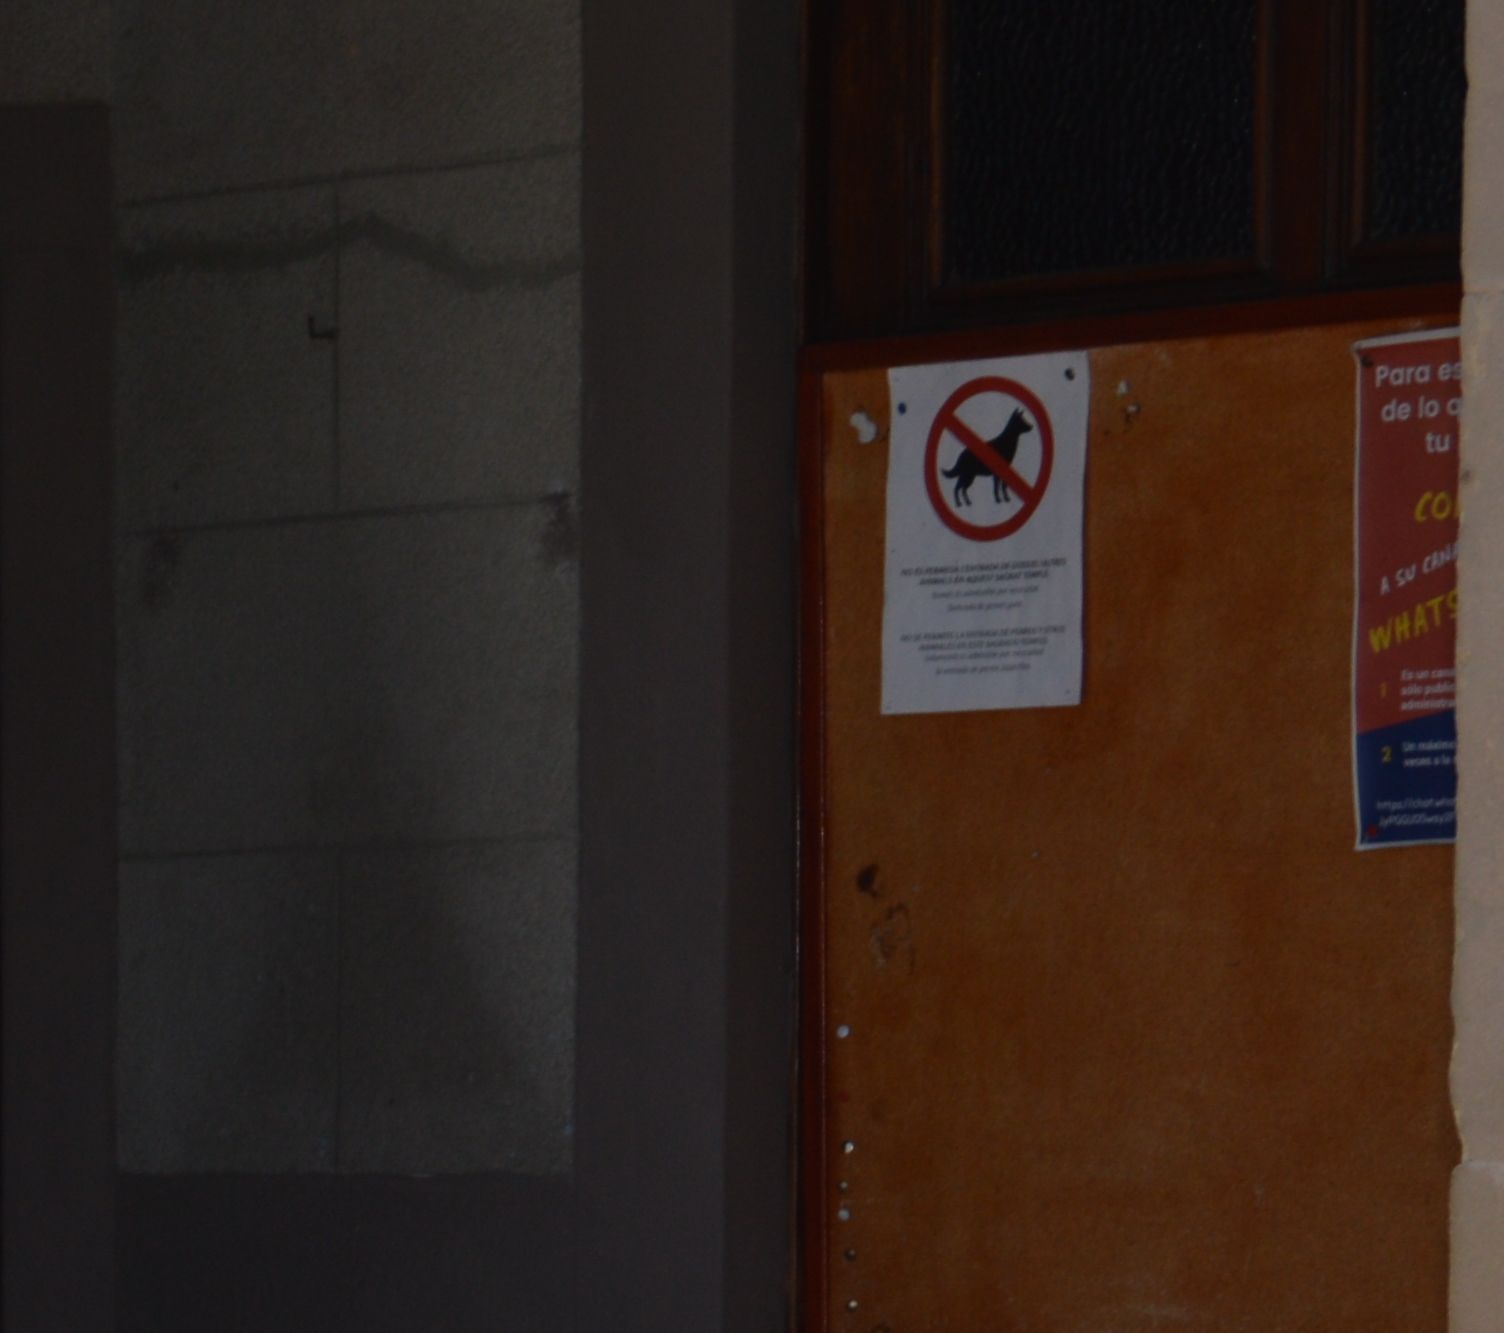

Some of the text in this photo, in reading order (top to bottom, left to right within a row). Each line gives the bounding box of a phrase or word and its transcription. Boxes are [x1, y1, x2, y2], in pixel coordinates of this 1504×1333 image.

[1374, 363, 1431, 388] Para
[1381, 398, 1411, 423] de
[1418, 395, 1441, 420] lo
[1424, 431, 1451, 454] tu
[1414, 490, 1462, 522] CO
[1379, 575, 1391, 596] A
[1395, 562, 1417, 588] SU
[1380, 745, 1393, 764] 2
